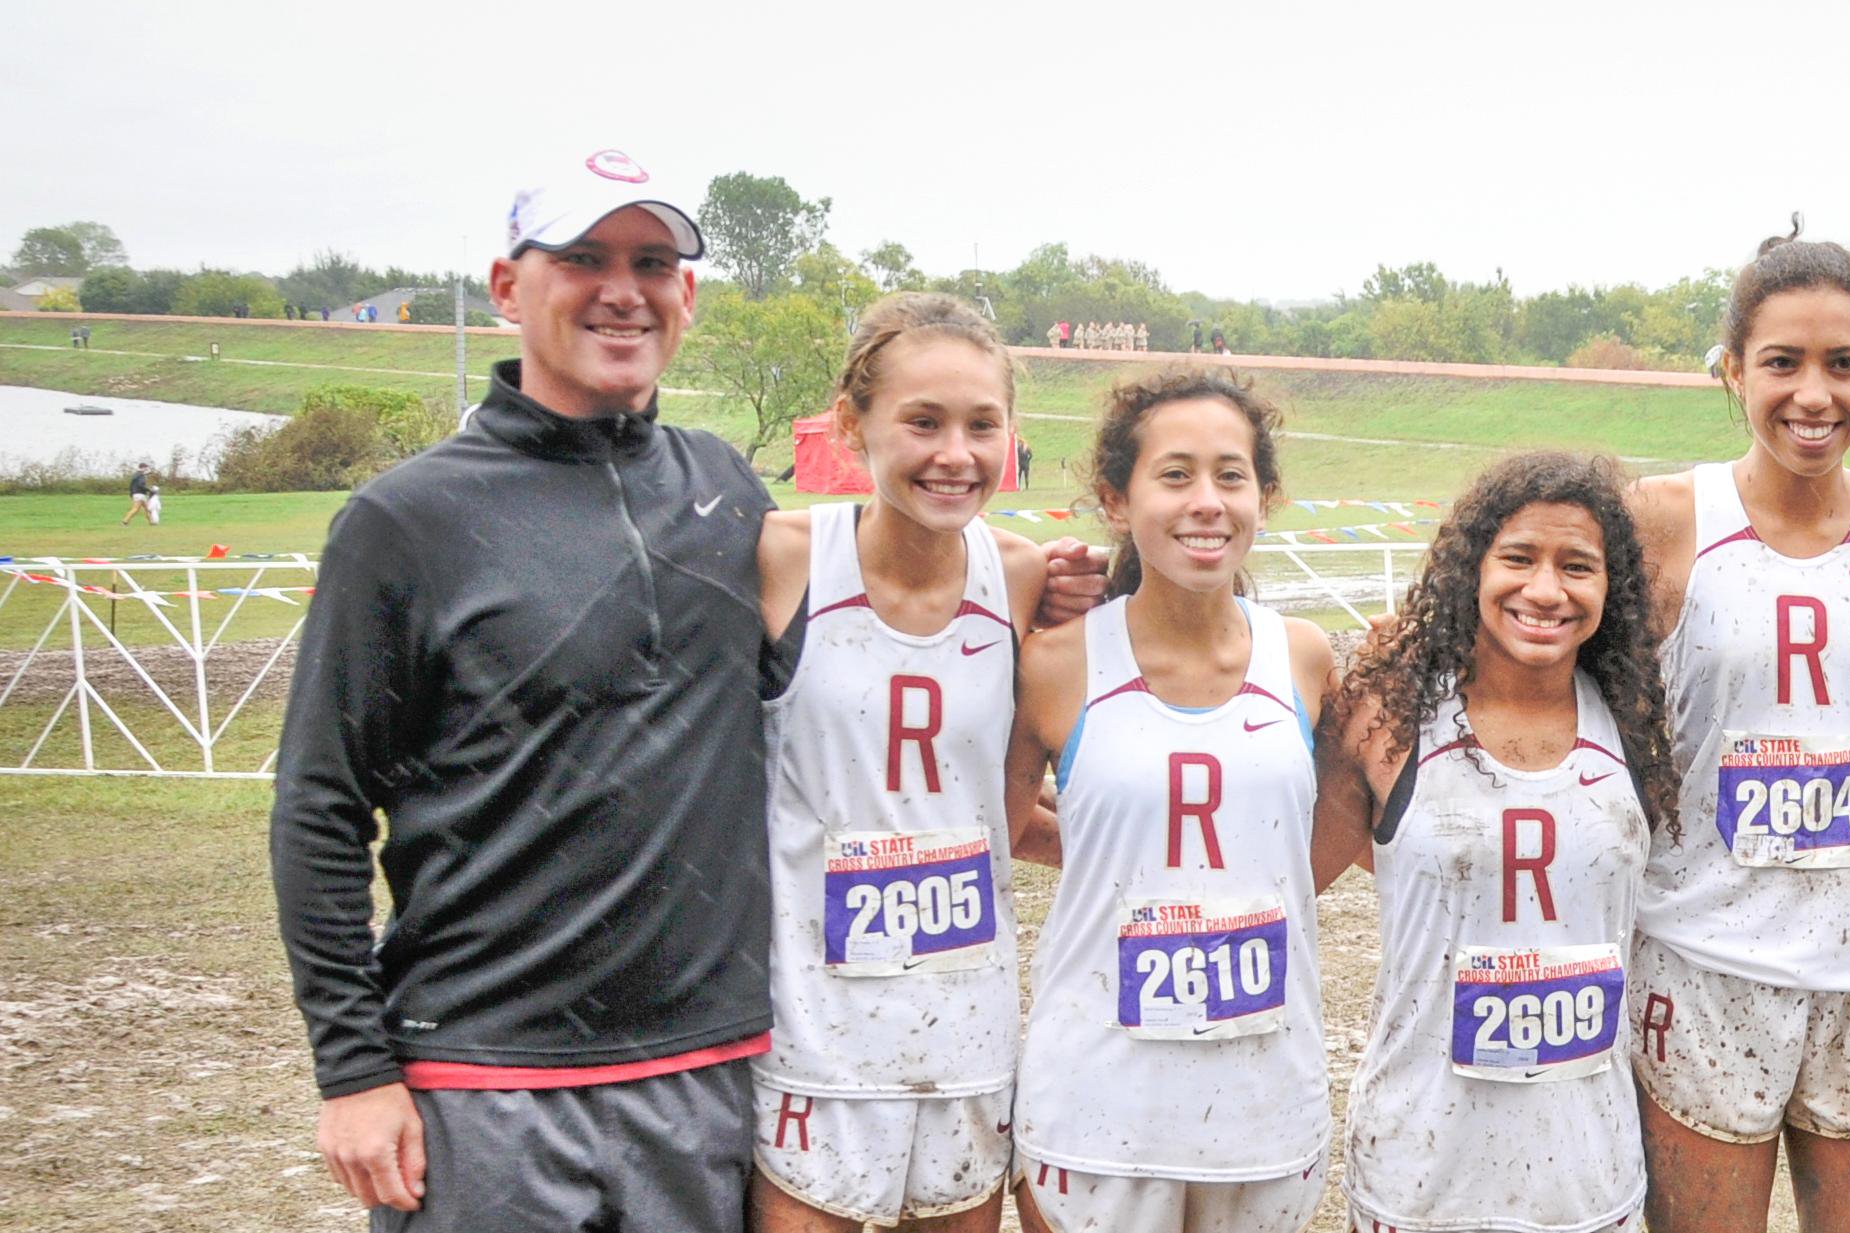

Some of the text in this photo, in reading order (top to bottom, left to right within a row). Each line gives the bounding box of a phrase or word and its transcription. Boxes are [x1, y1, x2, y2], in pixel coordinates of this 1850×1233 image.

[1776, 594, 1831, 706] R
[887, 674, 943, 793] R
[1722, 753, 1752, 766] CROSS
[1756, 753, 1800, 766] COUNTRY
[1760, 739, 1800, 753] STATE
[1168, 752, 1225, 870] R
[828, 857, 863, 872] CROSS
[867, 854, 914, 869] COUNTRY
[870, 837, 913, 855] STATE
[1503, 808, 1557, 922] R
[846, 870, 981, 939] 2605
[1120, 923, 1152, 936] CROSS
[1156, 919, 1203, 935] COUNTRY
[1159, 905, 1201, 920] STATE
[1136, 938, 1271, 1004] 2610
[1458, 956, 1619, 982] CROSS COUNTRY CHAMPIONSHIPS
[1498, 954, 1539, 969] STATE
[1473, 985, 1604, 1049] 2609
[1642, 992, 1674, 1063] R
[774, 1092, 813, 1151] R
